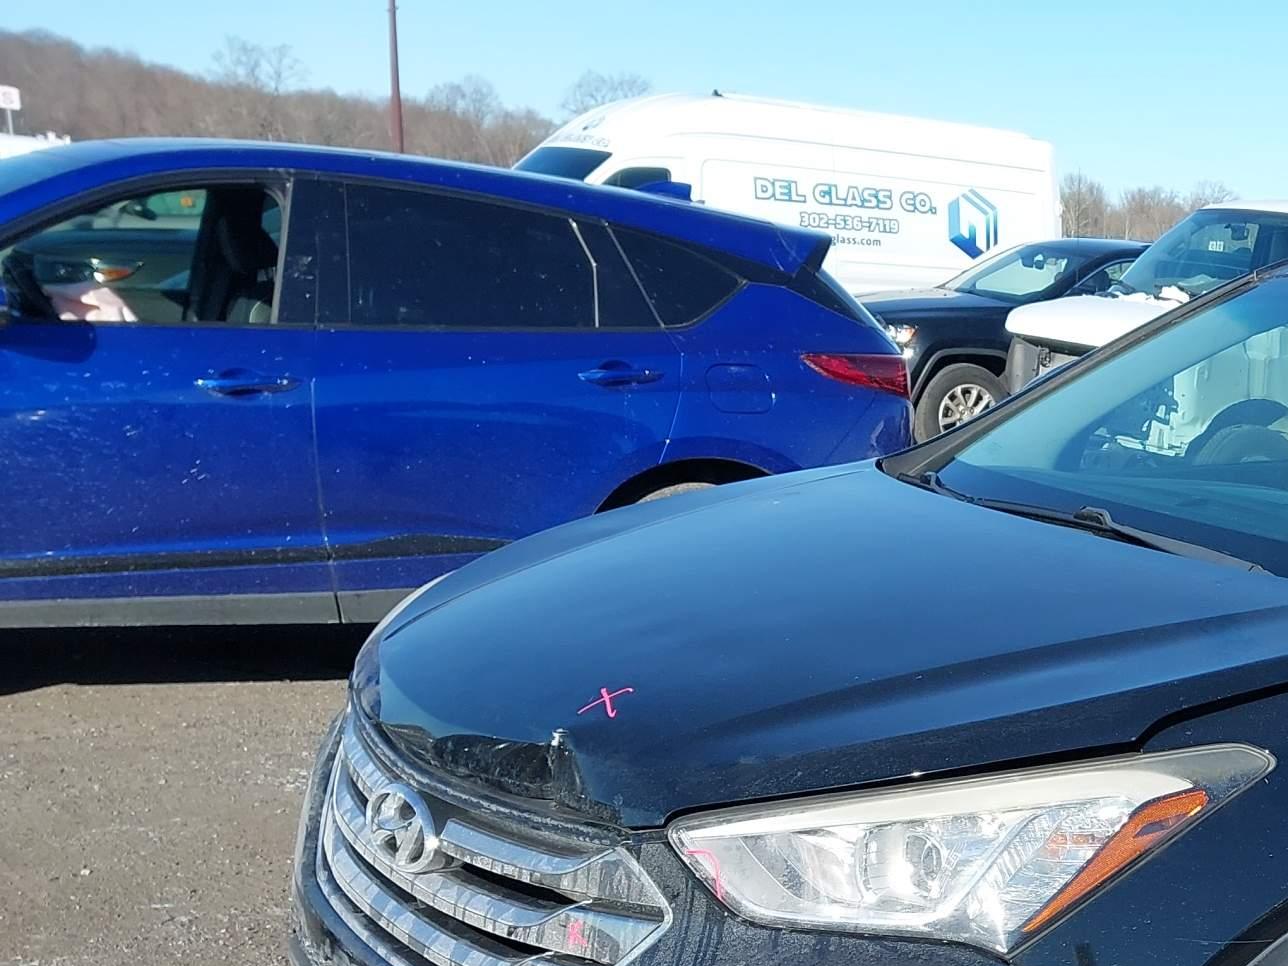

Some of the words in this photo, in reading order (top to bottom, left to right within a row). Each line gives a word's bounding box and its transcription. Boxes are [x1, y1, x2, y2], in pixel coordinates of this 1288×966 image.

[754, 178, 806, 203] DEL
[813, 184, 892, 210] GLASS
[900, 191, 936, 214] CO.
[800, 212, 899, 233] 302-536-7119
